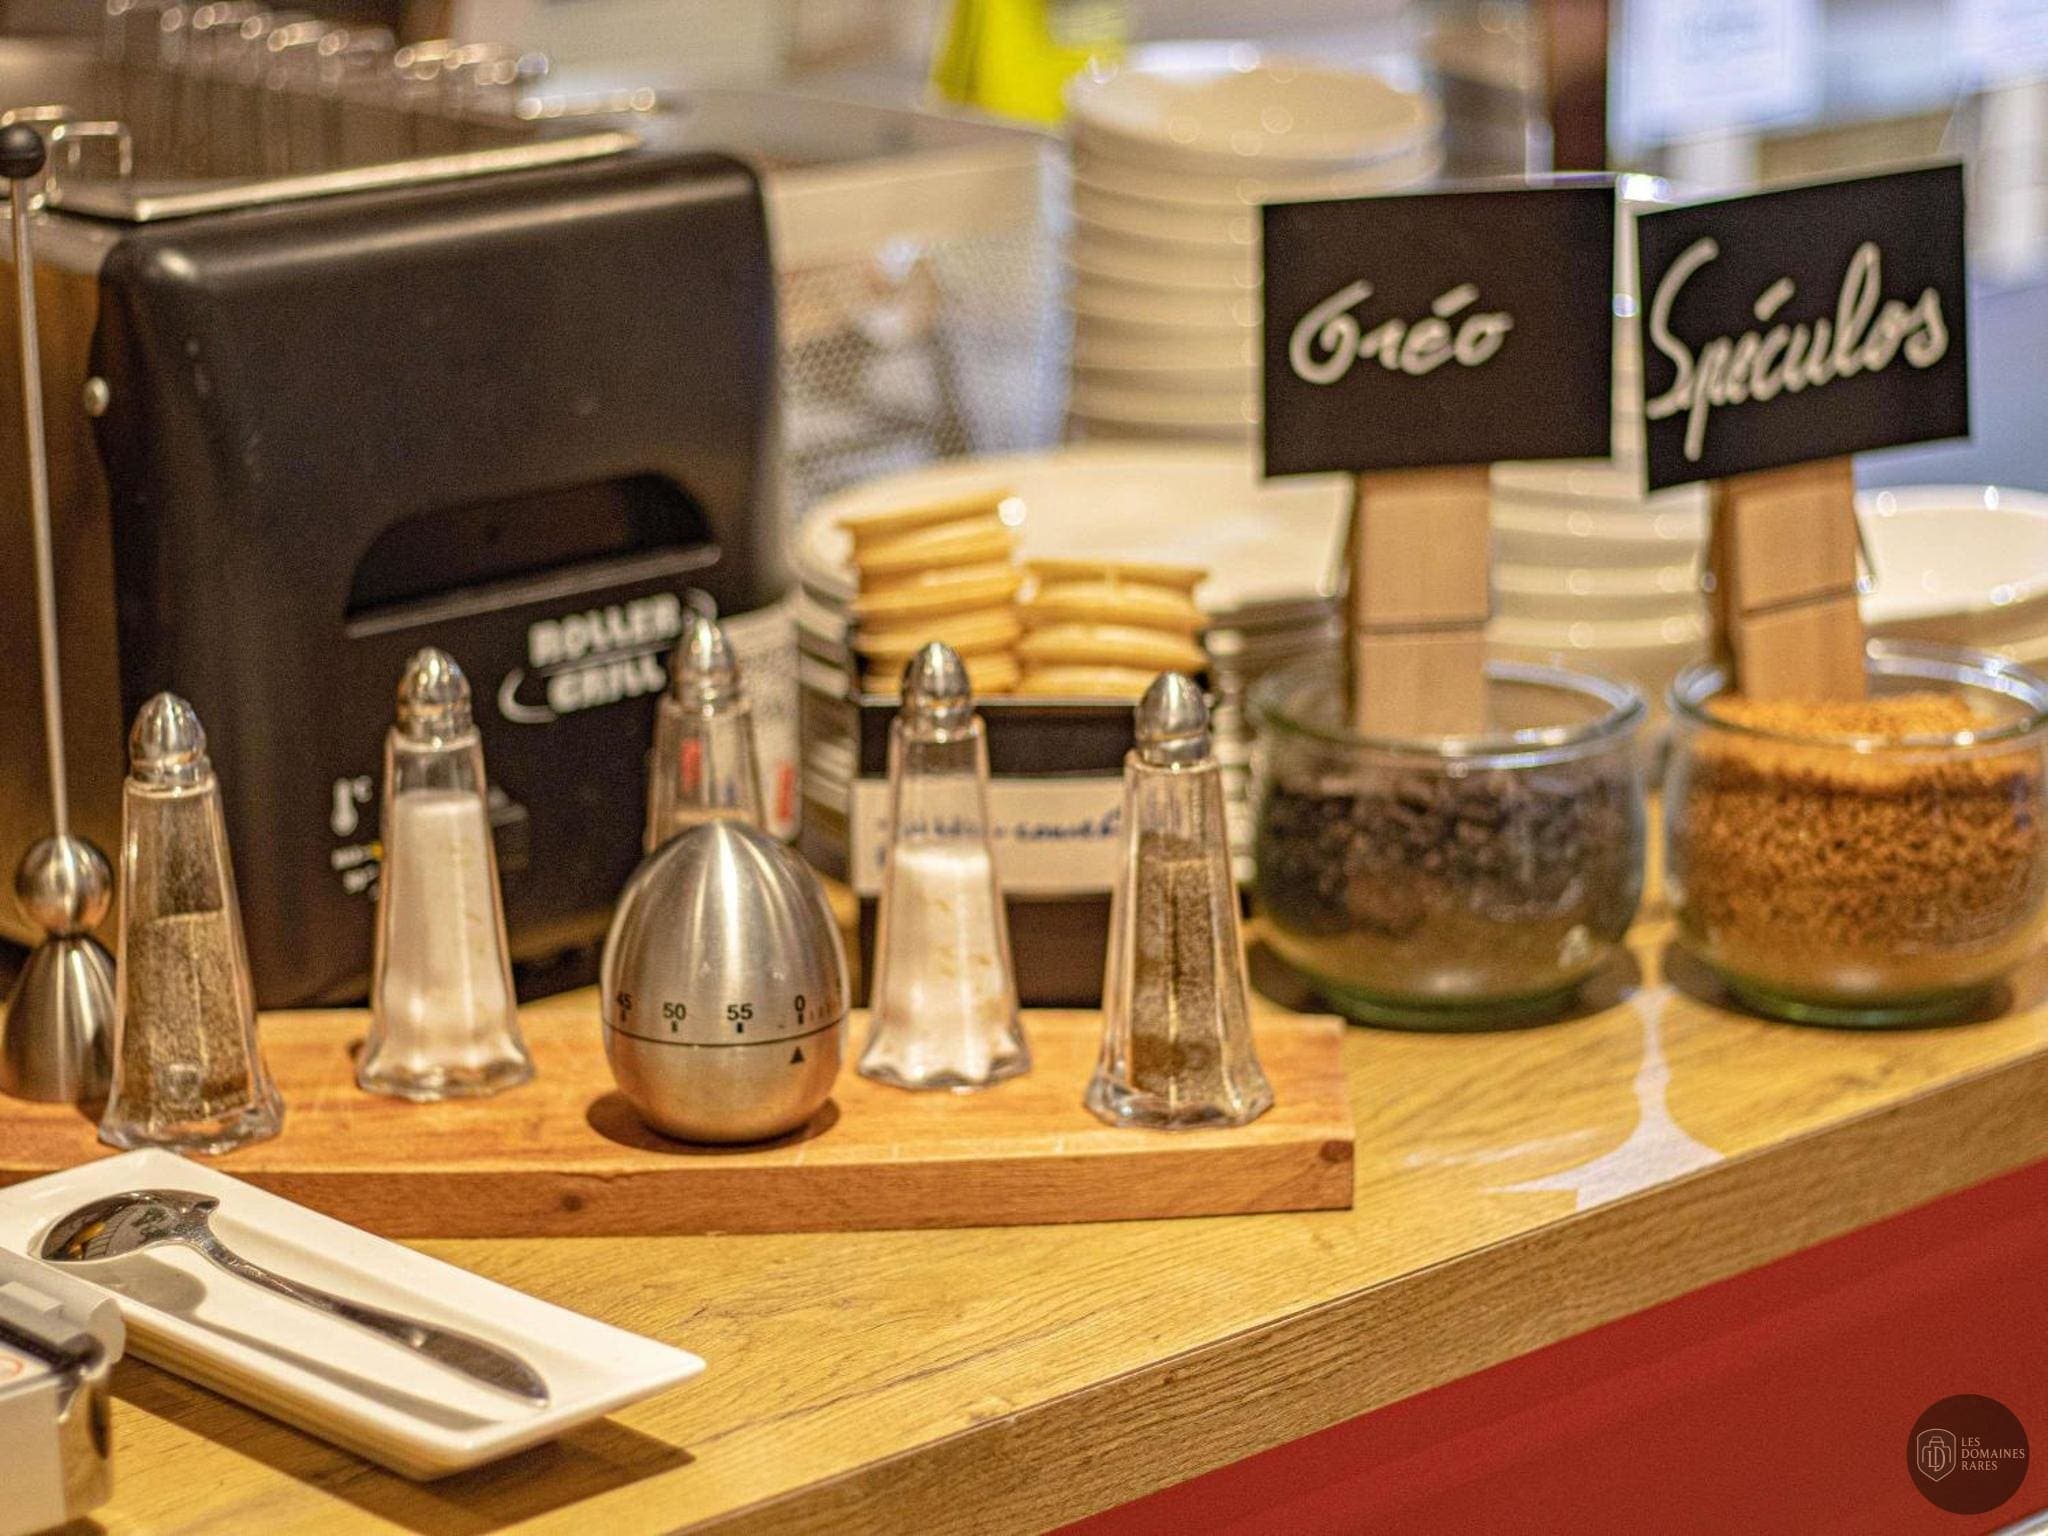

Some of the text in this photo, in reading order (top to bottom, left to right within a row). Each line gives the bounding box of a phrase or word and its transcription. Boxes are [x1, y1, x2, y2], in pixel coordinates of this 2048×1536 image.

[1646, 237, 1949, 462] Spéculos
[662, 1003, 687, 1020] 50
[726, 1003, 754, 1020] 55
[794, 994, 806, 1012] 0
